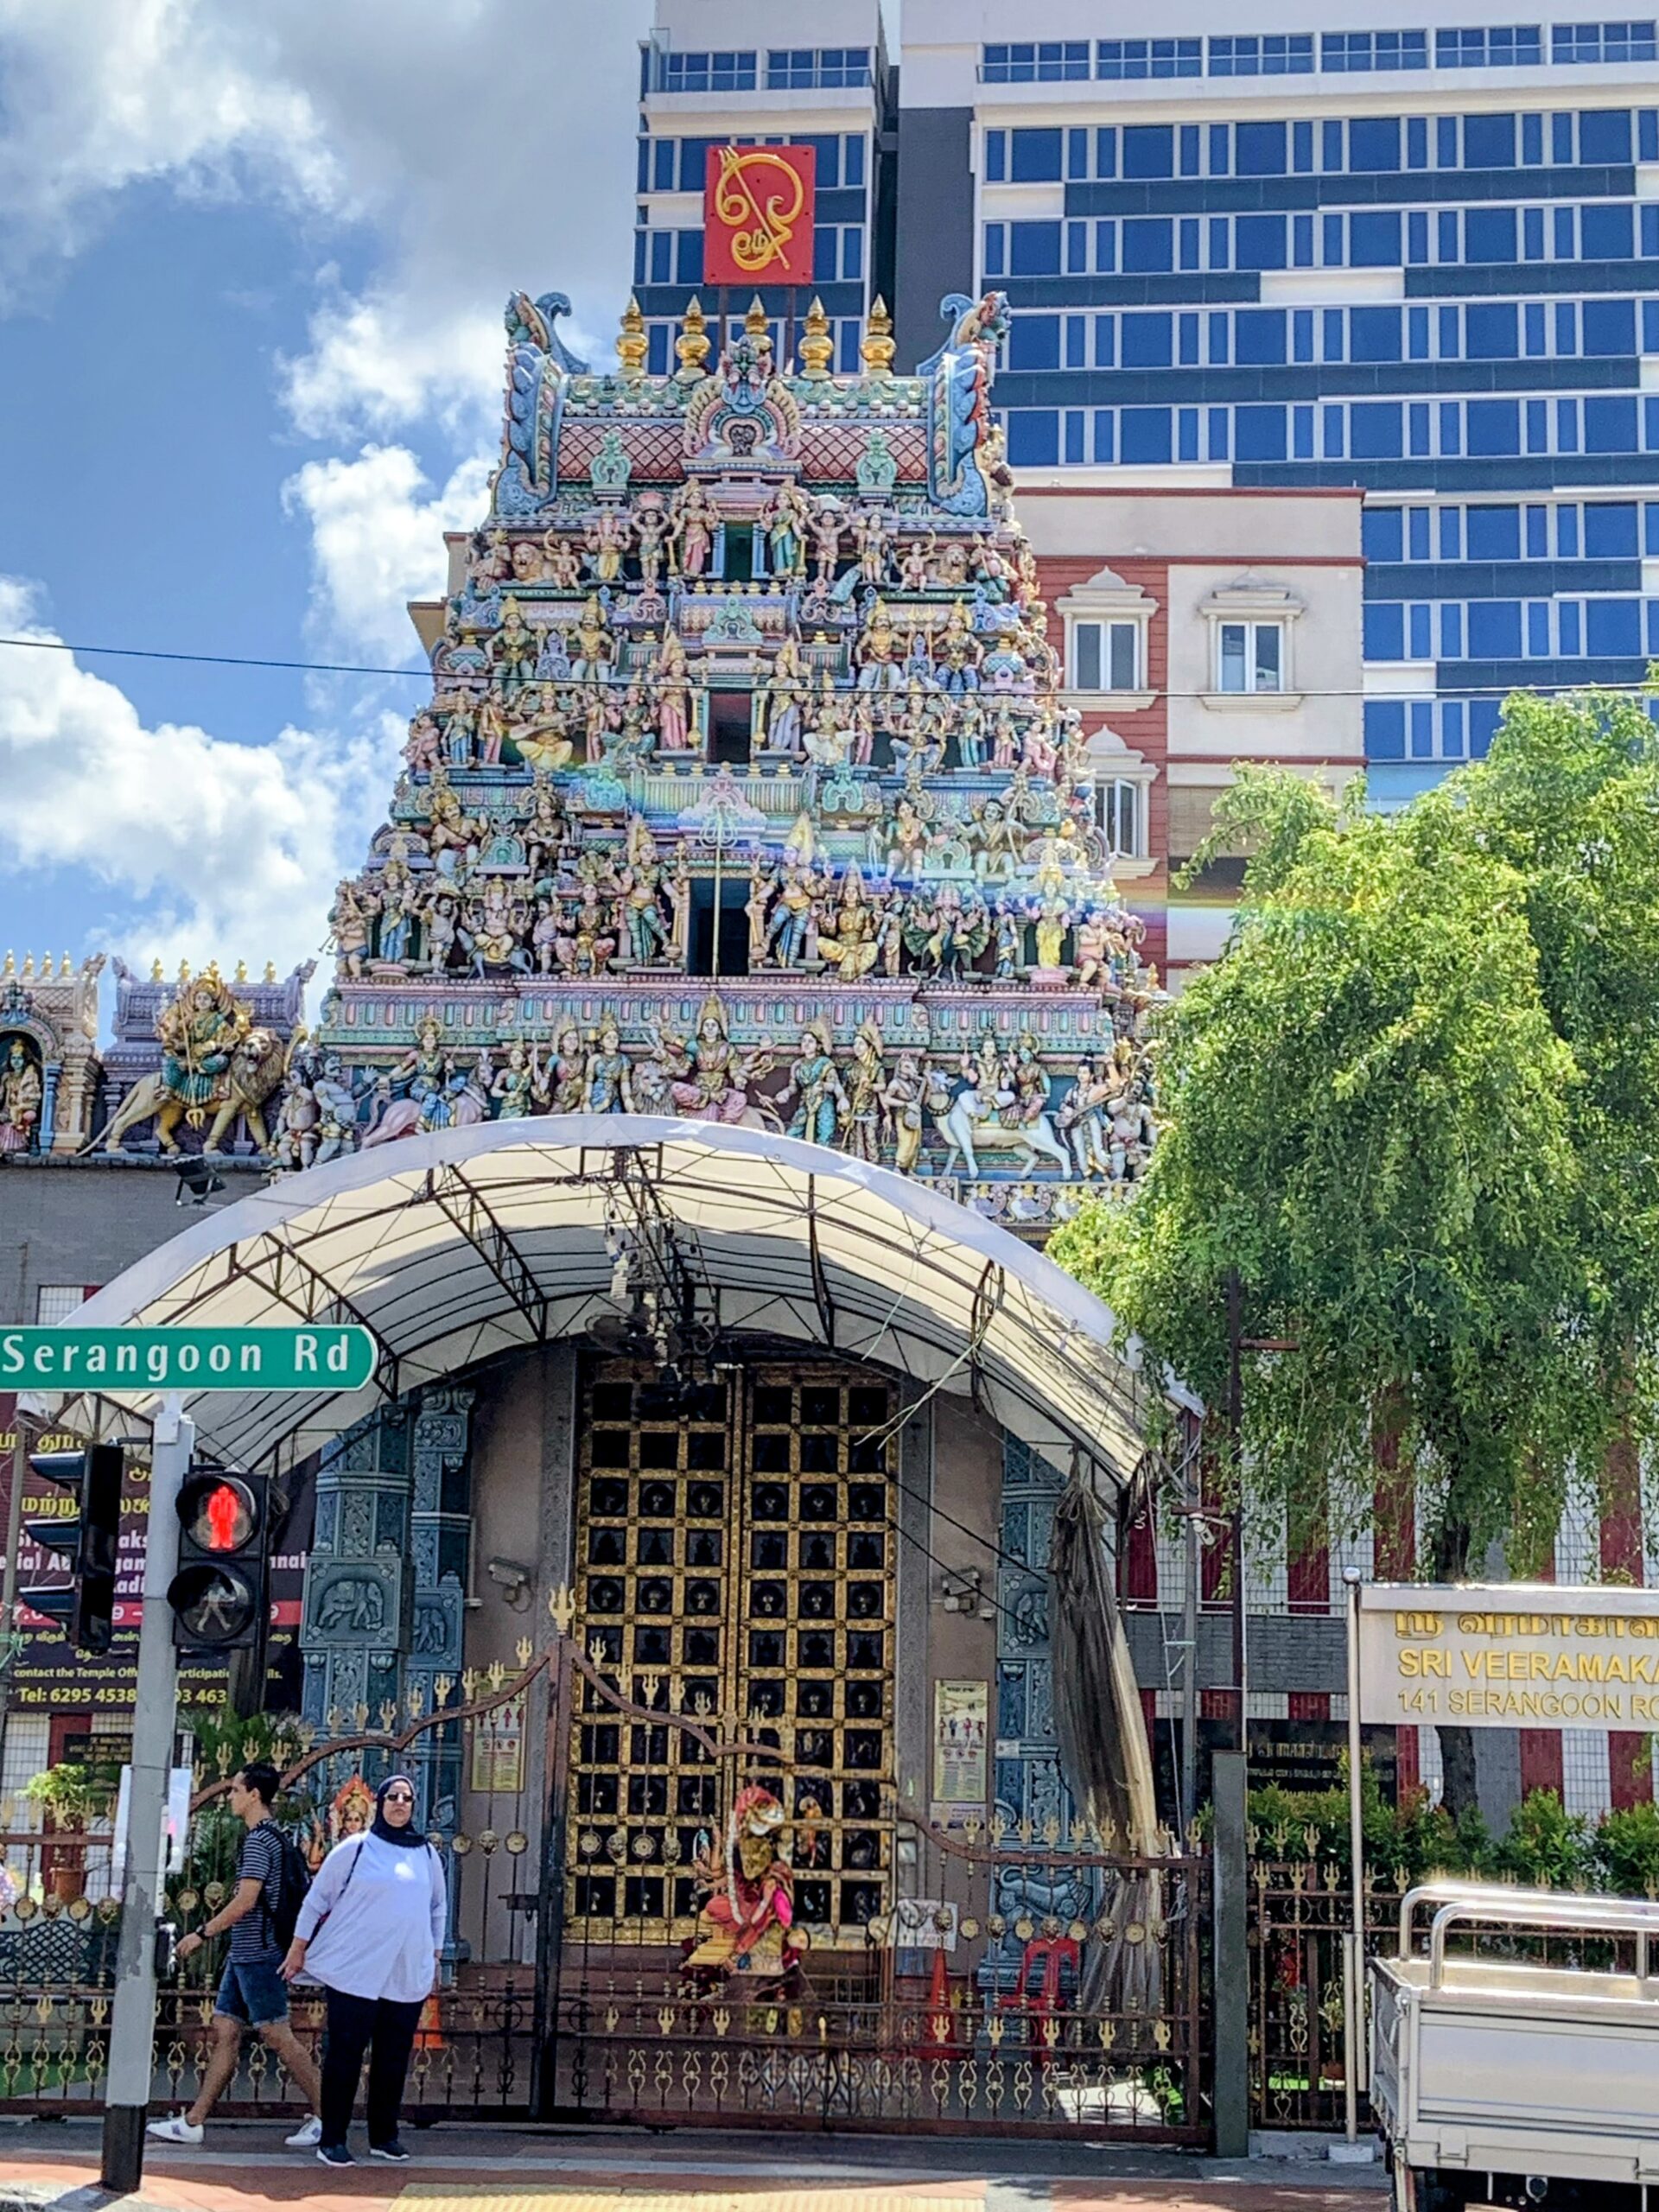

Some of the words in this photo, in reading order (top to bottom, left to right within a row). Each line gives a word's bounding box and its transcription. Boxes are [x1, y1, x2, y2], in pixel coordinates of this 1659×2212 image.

[2, 1334, 261, 1382] Serangoon
[294, 1333, 349, 1372] Rd
[13, 1668, 55, 1678] contact
[56, 1668, 75, 1678] the
[77, 1667, 116, 1680] Temple
[1397, 1648, 1452, 1678] SRI
[19, 1688, 47, 1703] Tel:
[49, 1688, 92, 1703] 6295
[94, 1688, 138, 1703] 4538
[1397, 1688, 1440, 1713] 141
[1447, 1688, 1623, 1719] SERANGOON
